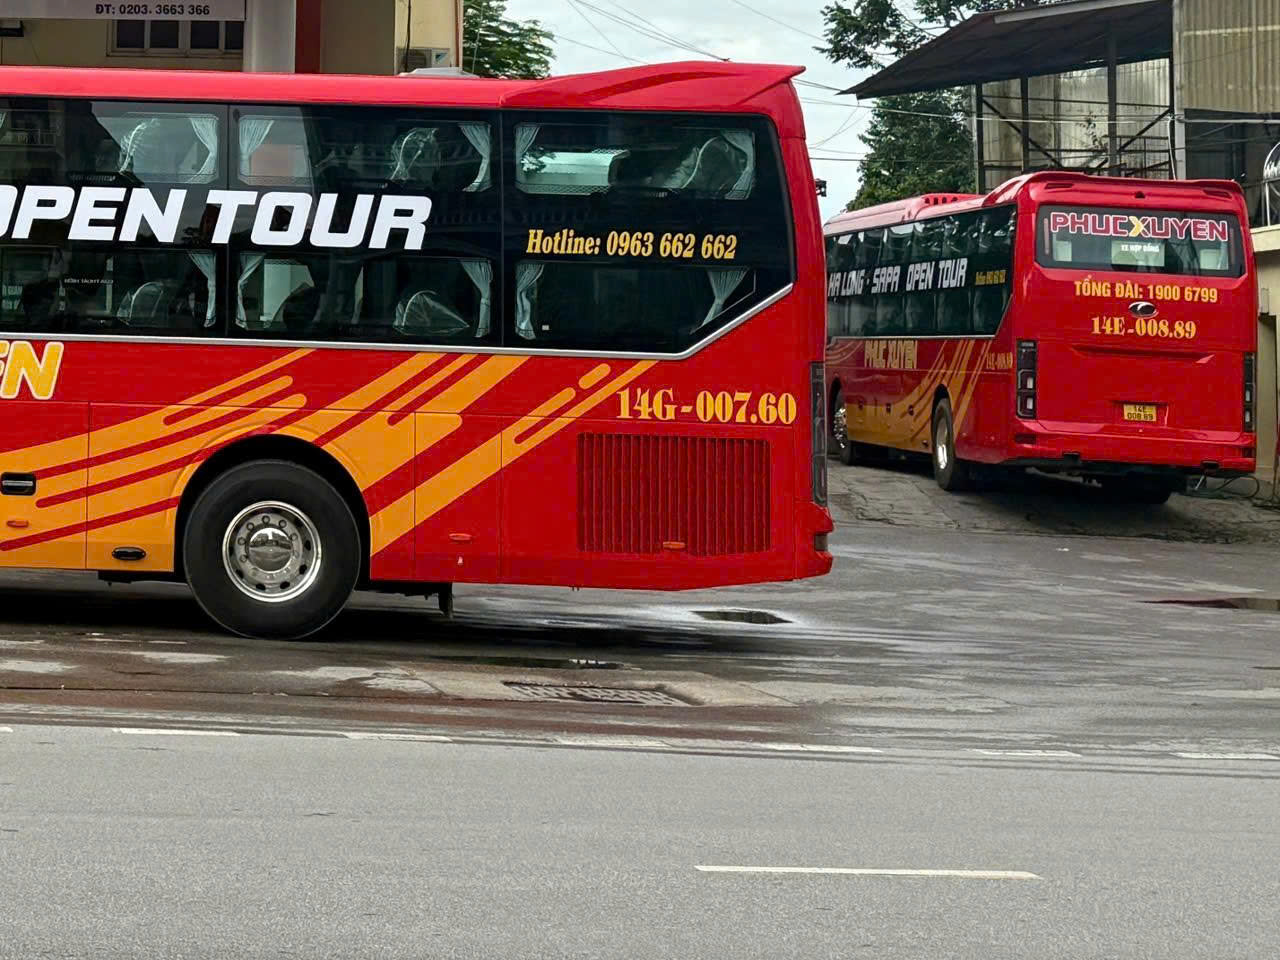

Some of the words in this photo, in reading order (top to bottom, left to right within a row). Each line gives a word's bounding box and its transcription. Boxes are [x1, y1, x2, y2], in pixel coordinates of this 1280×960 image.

[95, 3, 115, 16] ĐT:
[155, 4, 184, 16] 3663
[188, 4, 210, 16] 366
[205, 190, 432, 250] TOUR
[526, 228, 600, 254] Hotline:
[606, 230, 654, 257] 0963
[659, 232, 695, 258] 662
[701, 234, 737, 260] 662
[841, 269, 865, 296] LONG
[871, 266, 901, 293] SAPA
[906, 261, 936, 291] OPEN
[938, 257, 968, 289] TOUR
[1074, 274, 1111, 298] TỔNG
[1115, 279, 1143, 300] ĐÀI:
[1147, 284, 1181, 301] 1900
[1184, 286, 1218, 303] 6799
[1091, 316, 1197, 339] 14E-008.89
[616, 387, 797, 425] 14G-007.60
